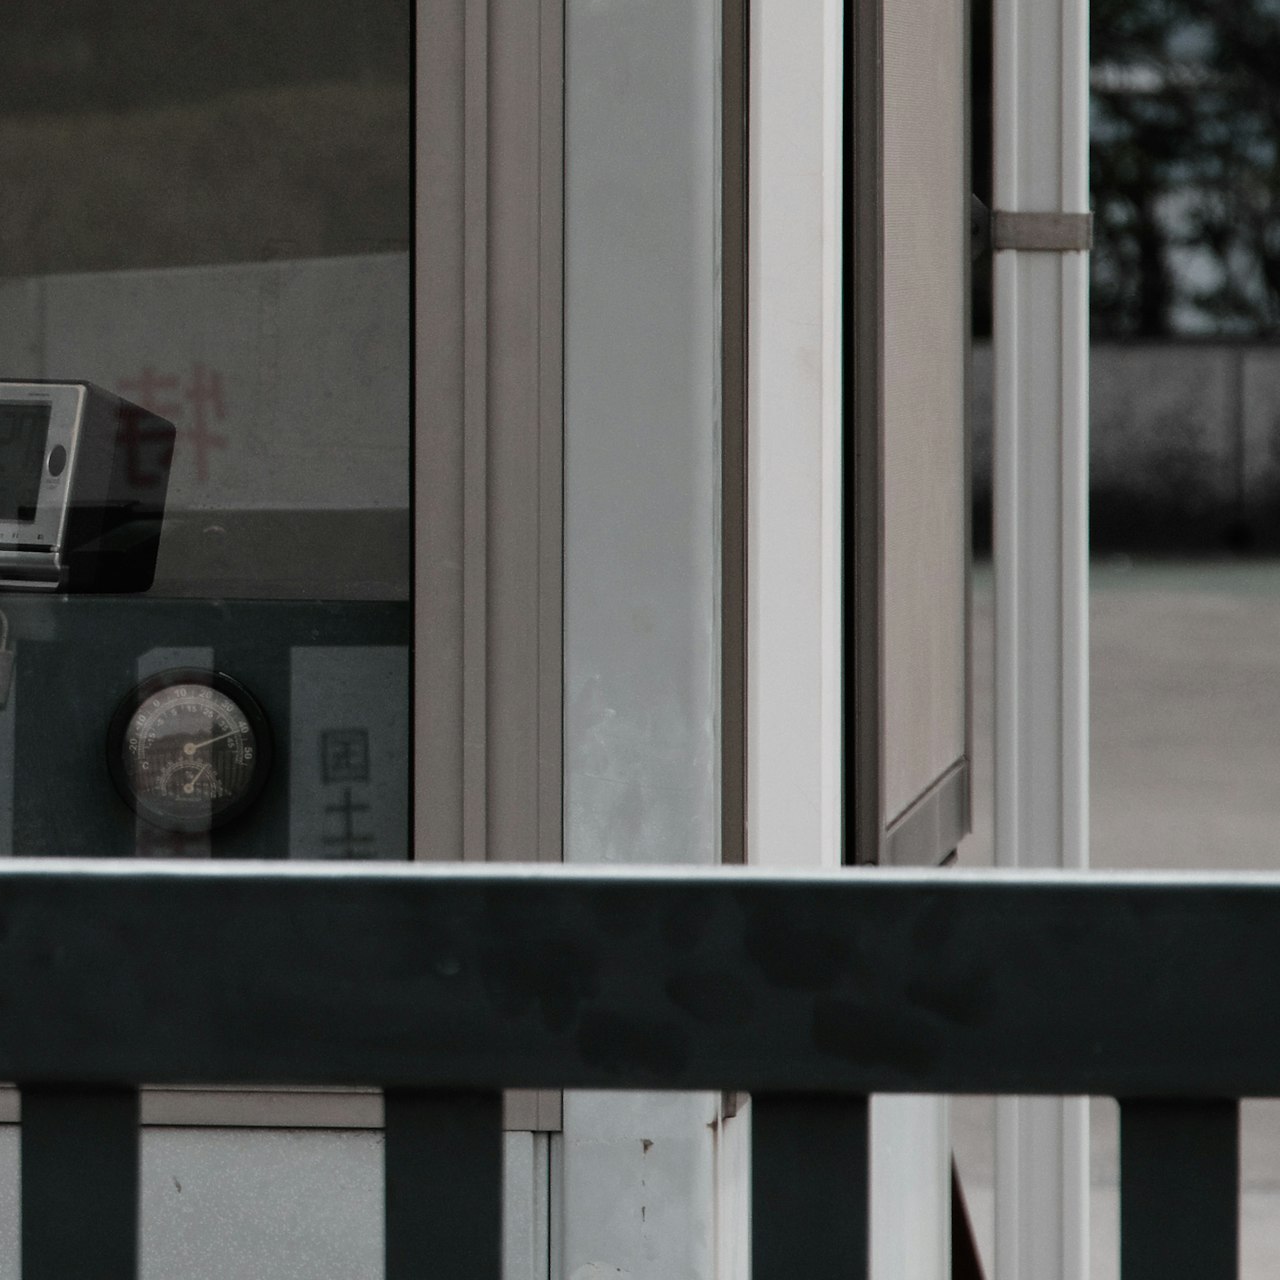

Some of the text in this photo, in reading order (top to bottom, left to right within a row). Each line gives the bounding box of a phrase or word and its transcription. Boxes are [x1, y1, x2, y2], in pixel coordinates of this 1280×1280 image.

[174, 688, 188, 698] 10
[199, 690, 213, 700] 20
[243, 746, 253, 760] 50
